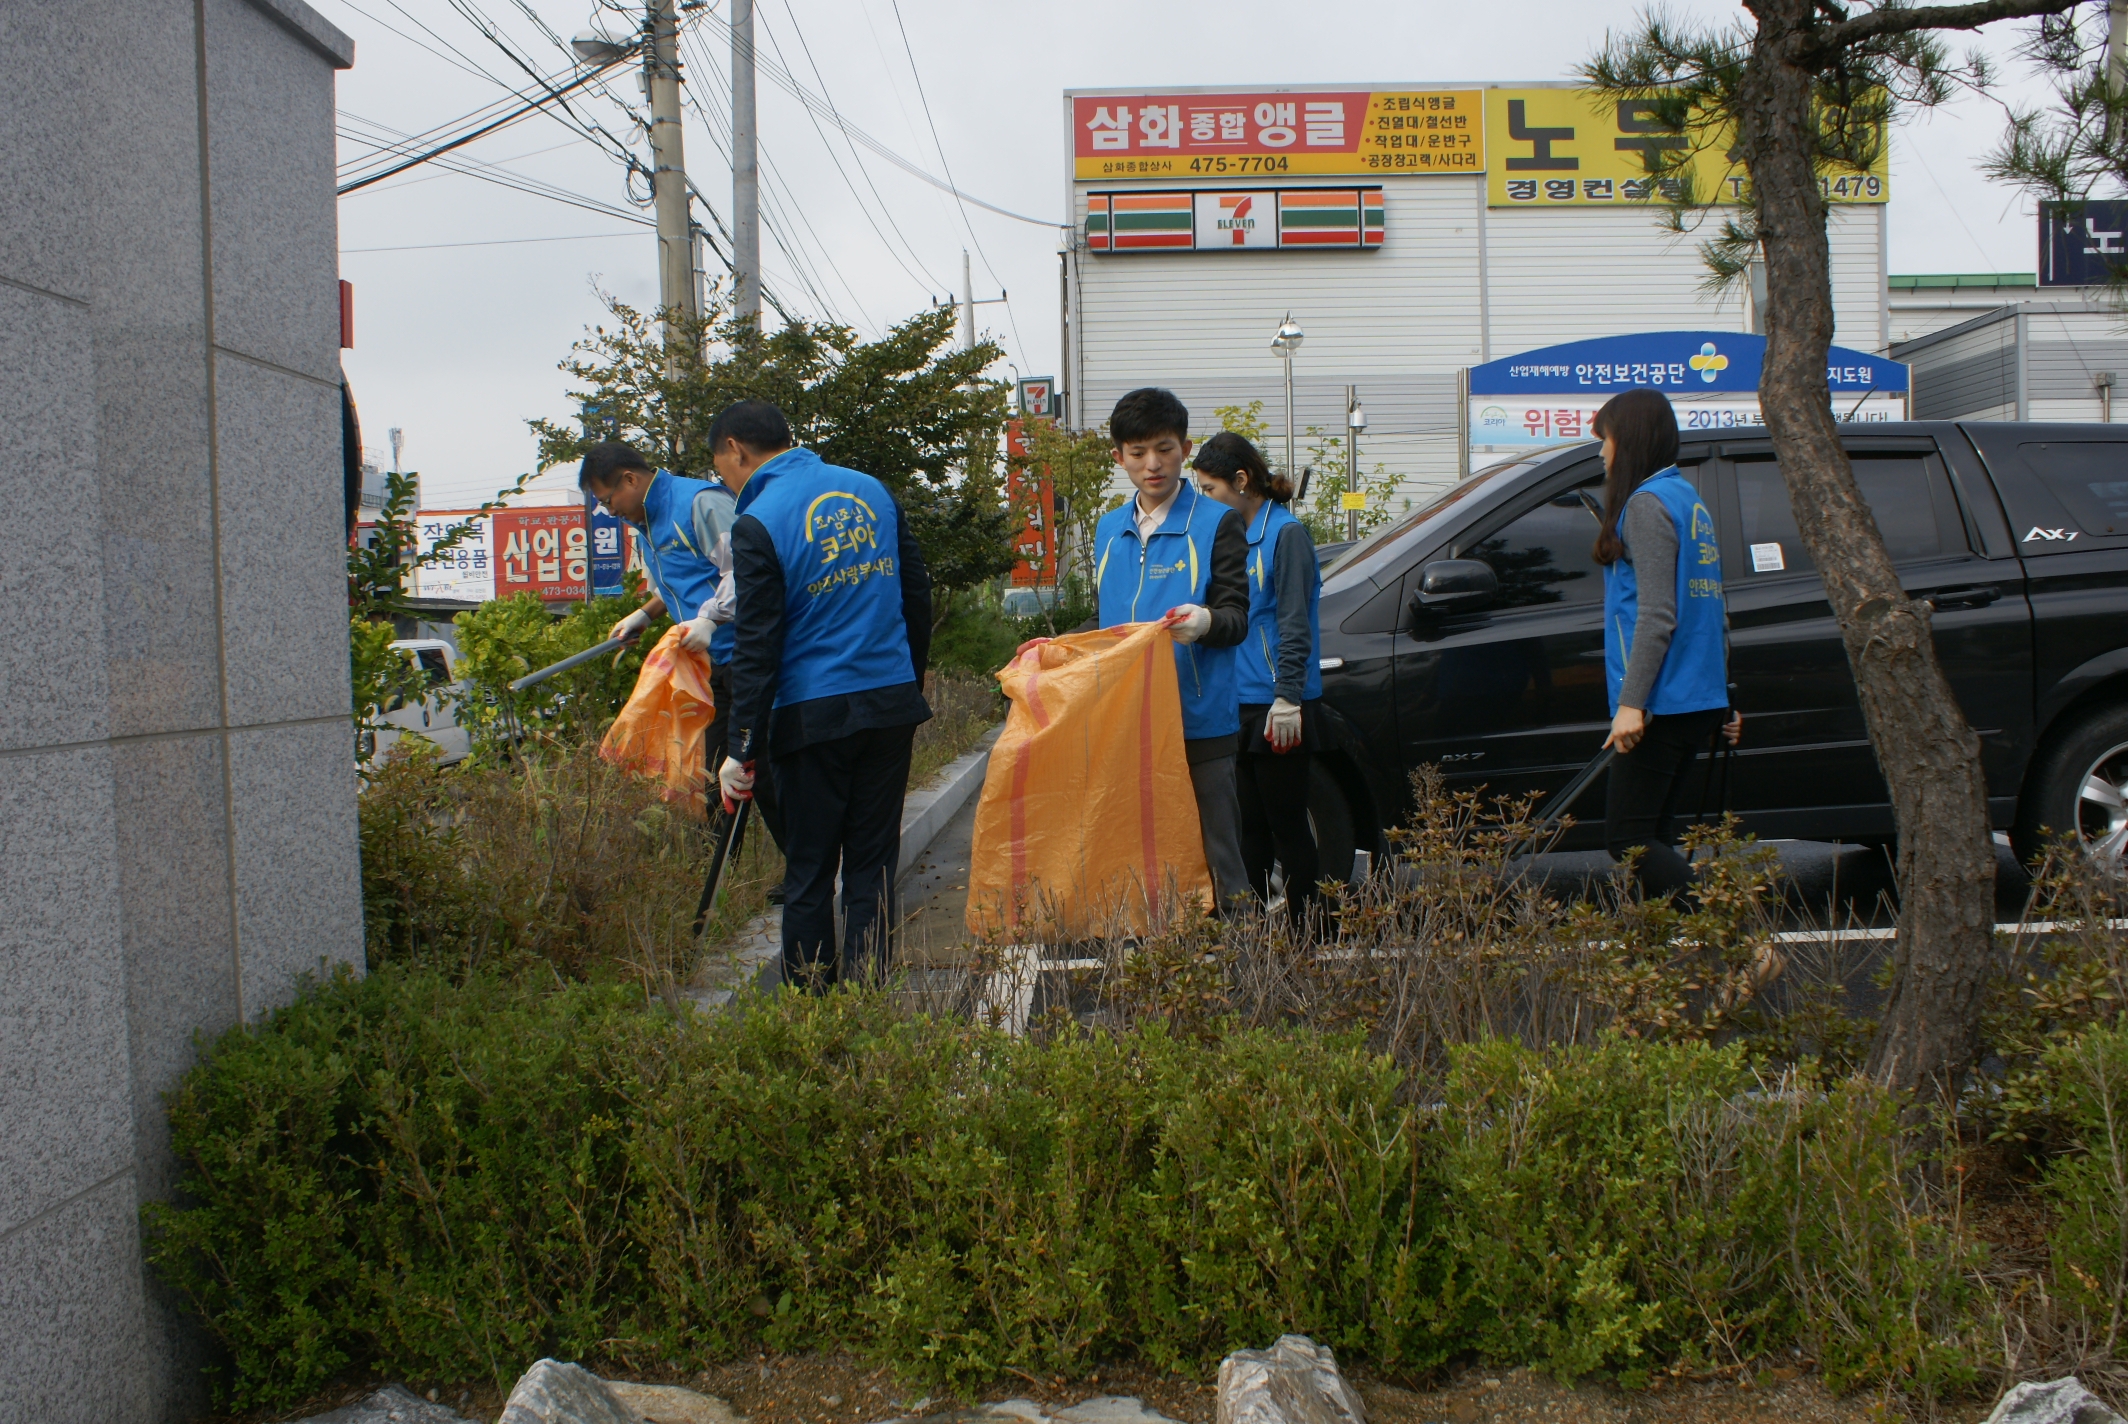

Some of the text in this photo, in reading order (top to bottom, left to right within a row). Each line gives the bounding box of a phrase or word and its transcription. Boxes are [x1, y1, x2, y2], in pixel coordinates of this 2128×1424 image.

[1086, 102, 1345, 149] 삼화 종합 앵글
[1103, 161, 1172, 174] 삼화종합상사
[1190, 156, 1289, 173] 475-7704
[1219, 196, 1252, 245] 7
[1509, 363, 1686, 385] 산업재해예방 안전보건공단
[1523, 409, 1599, 438] 위험
[820, 524, 877, 564] 코리아
[542, 586, 587, 595] 473-034
